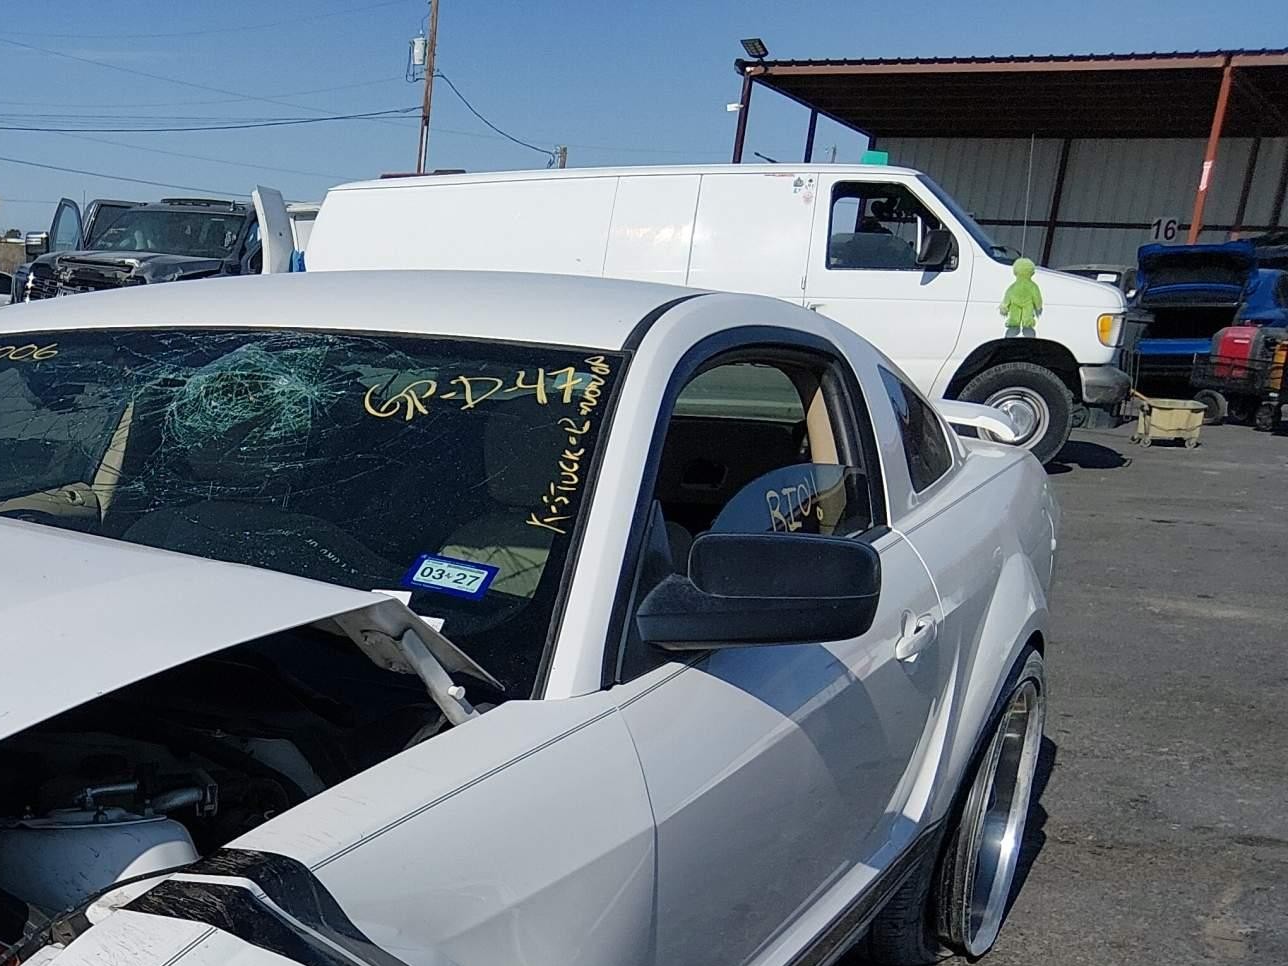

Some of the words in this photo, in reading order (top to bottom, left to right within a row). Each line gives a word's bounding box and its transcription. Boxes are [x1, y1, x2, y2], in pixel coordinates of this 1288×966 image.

[1151, 218, 1177, 241] 16
[420, 565, 447, 582] 03
[452, 571, 481, 588] 27
